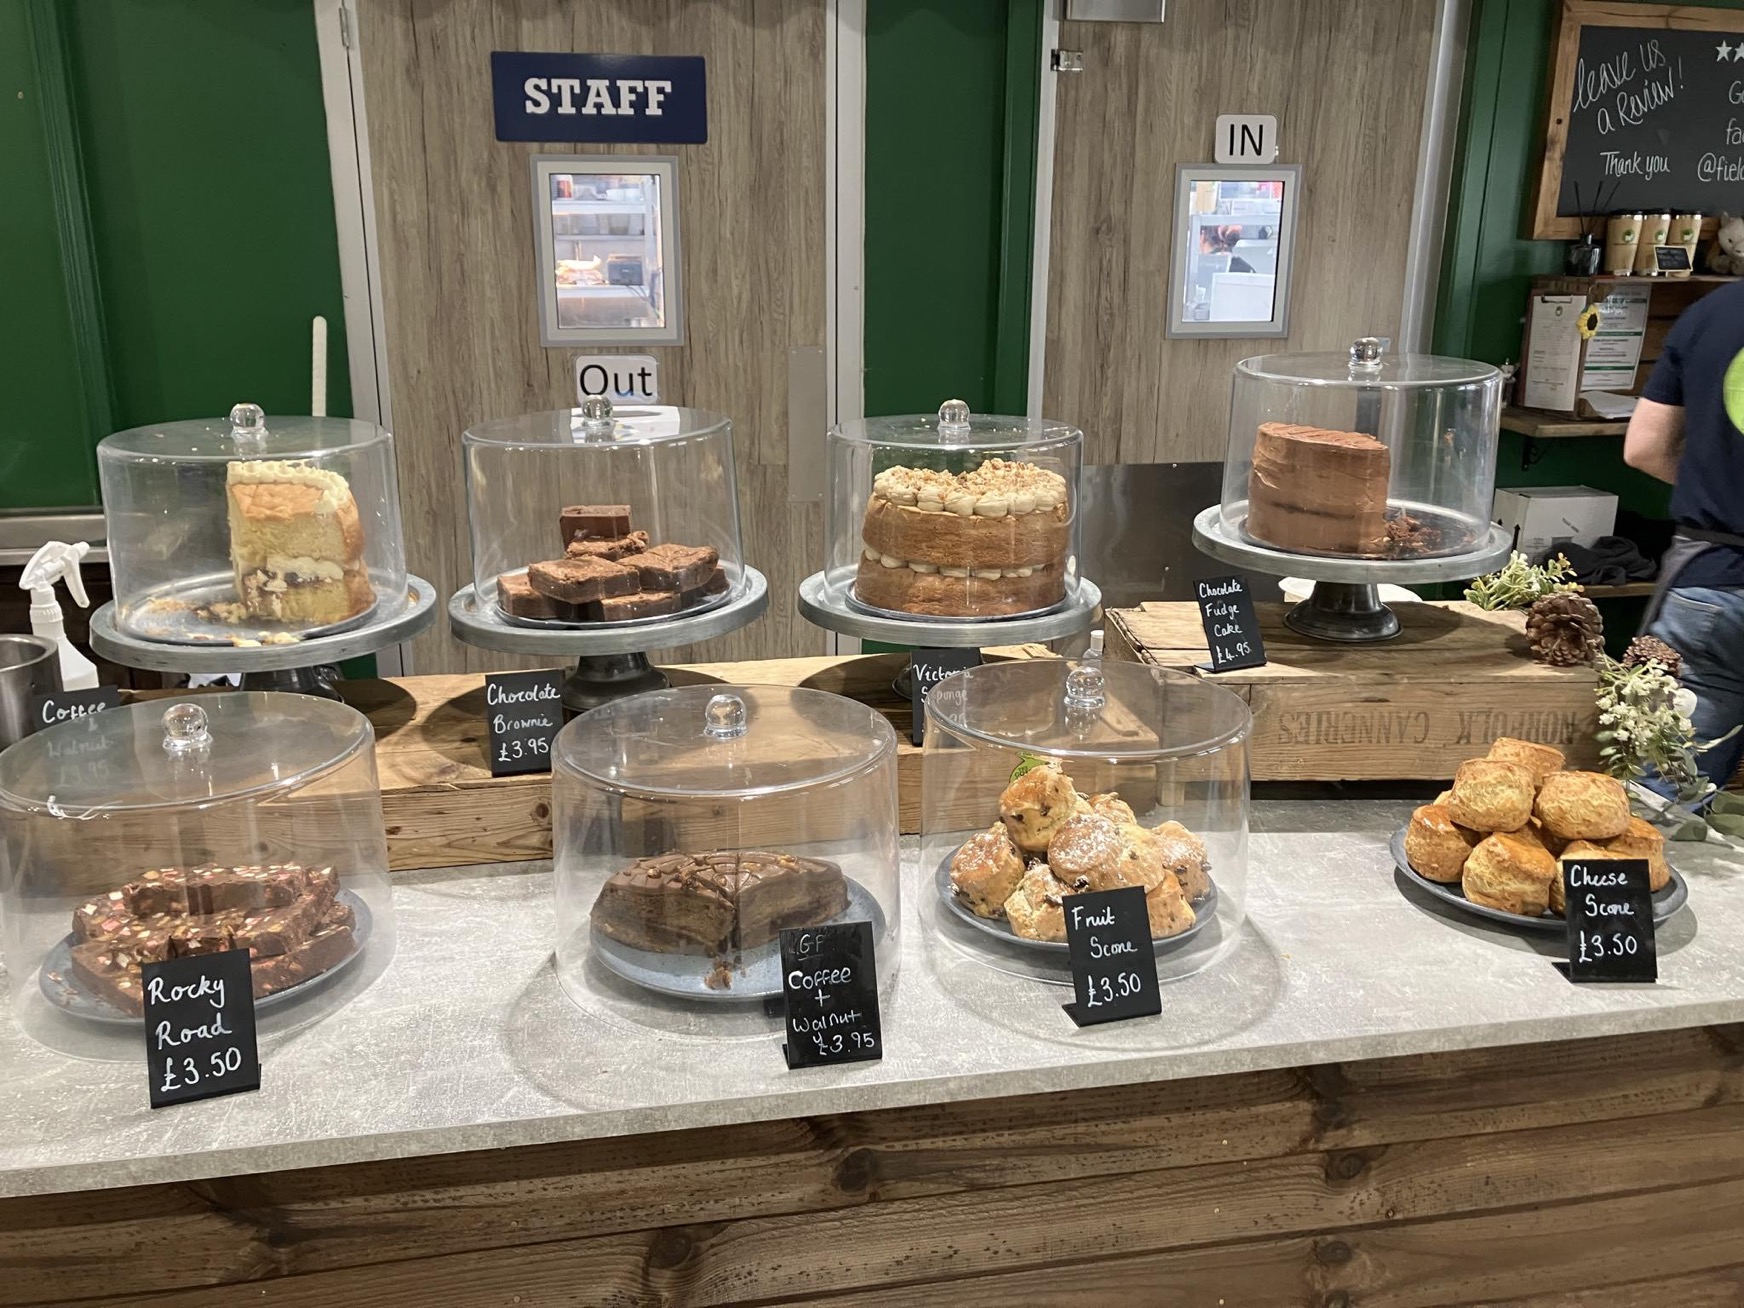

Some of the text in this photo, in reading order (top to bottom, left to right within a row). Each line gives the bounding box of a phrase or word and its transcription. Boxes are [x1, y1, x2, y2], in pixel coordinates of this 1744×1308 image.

[524, 77, 672, 115] STAFF
[1229, 124, 1264, 156] IN
[1600, 151, 1671, 181] Thank you
[579, 364, 653, 397] Out
[1199, 579, 1243, 598] Chocolate
[1205, 602, 1240, 620] Fudge
[1214, 623, 1243, 637] Cake
[1216, 641, 1252, 664] £4.95
[487, 683, 561, 705] Chocolate
[42, 700, 106, 723] Coffee
[493, 713, 553, 734] Brownie
[498, 737, 549, 762] £3.95
[1570, 864, 1628, 887] Cheese
[1585, 893, 1635, 916] Scone
[1071, 906, 1116, 930] Fruit
[1090, 936, 1138, 958] Scone
[1578, 930, 1638, 963] £3.50
[788, 966, 852, 990] Coffee
[1087, 972, 1142, 1008] £3.50
[148, 975, 226, 1009] Rocky
[155, 1012, 233, 1050] Road
[792, 1009, 863, 1033] Walnut
[812, 1030, 875, 1056] £3.95
[160, 1046, 242, 1093] £3.50
